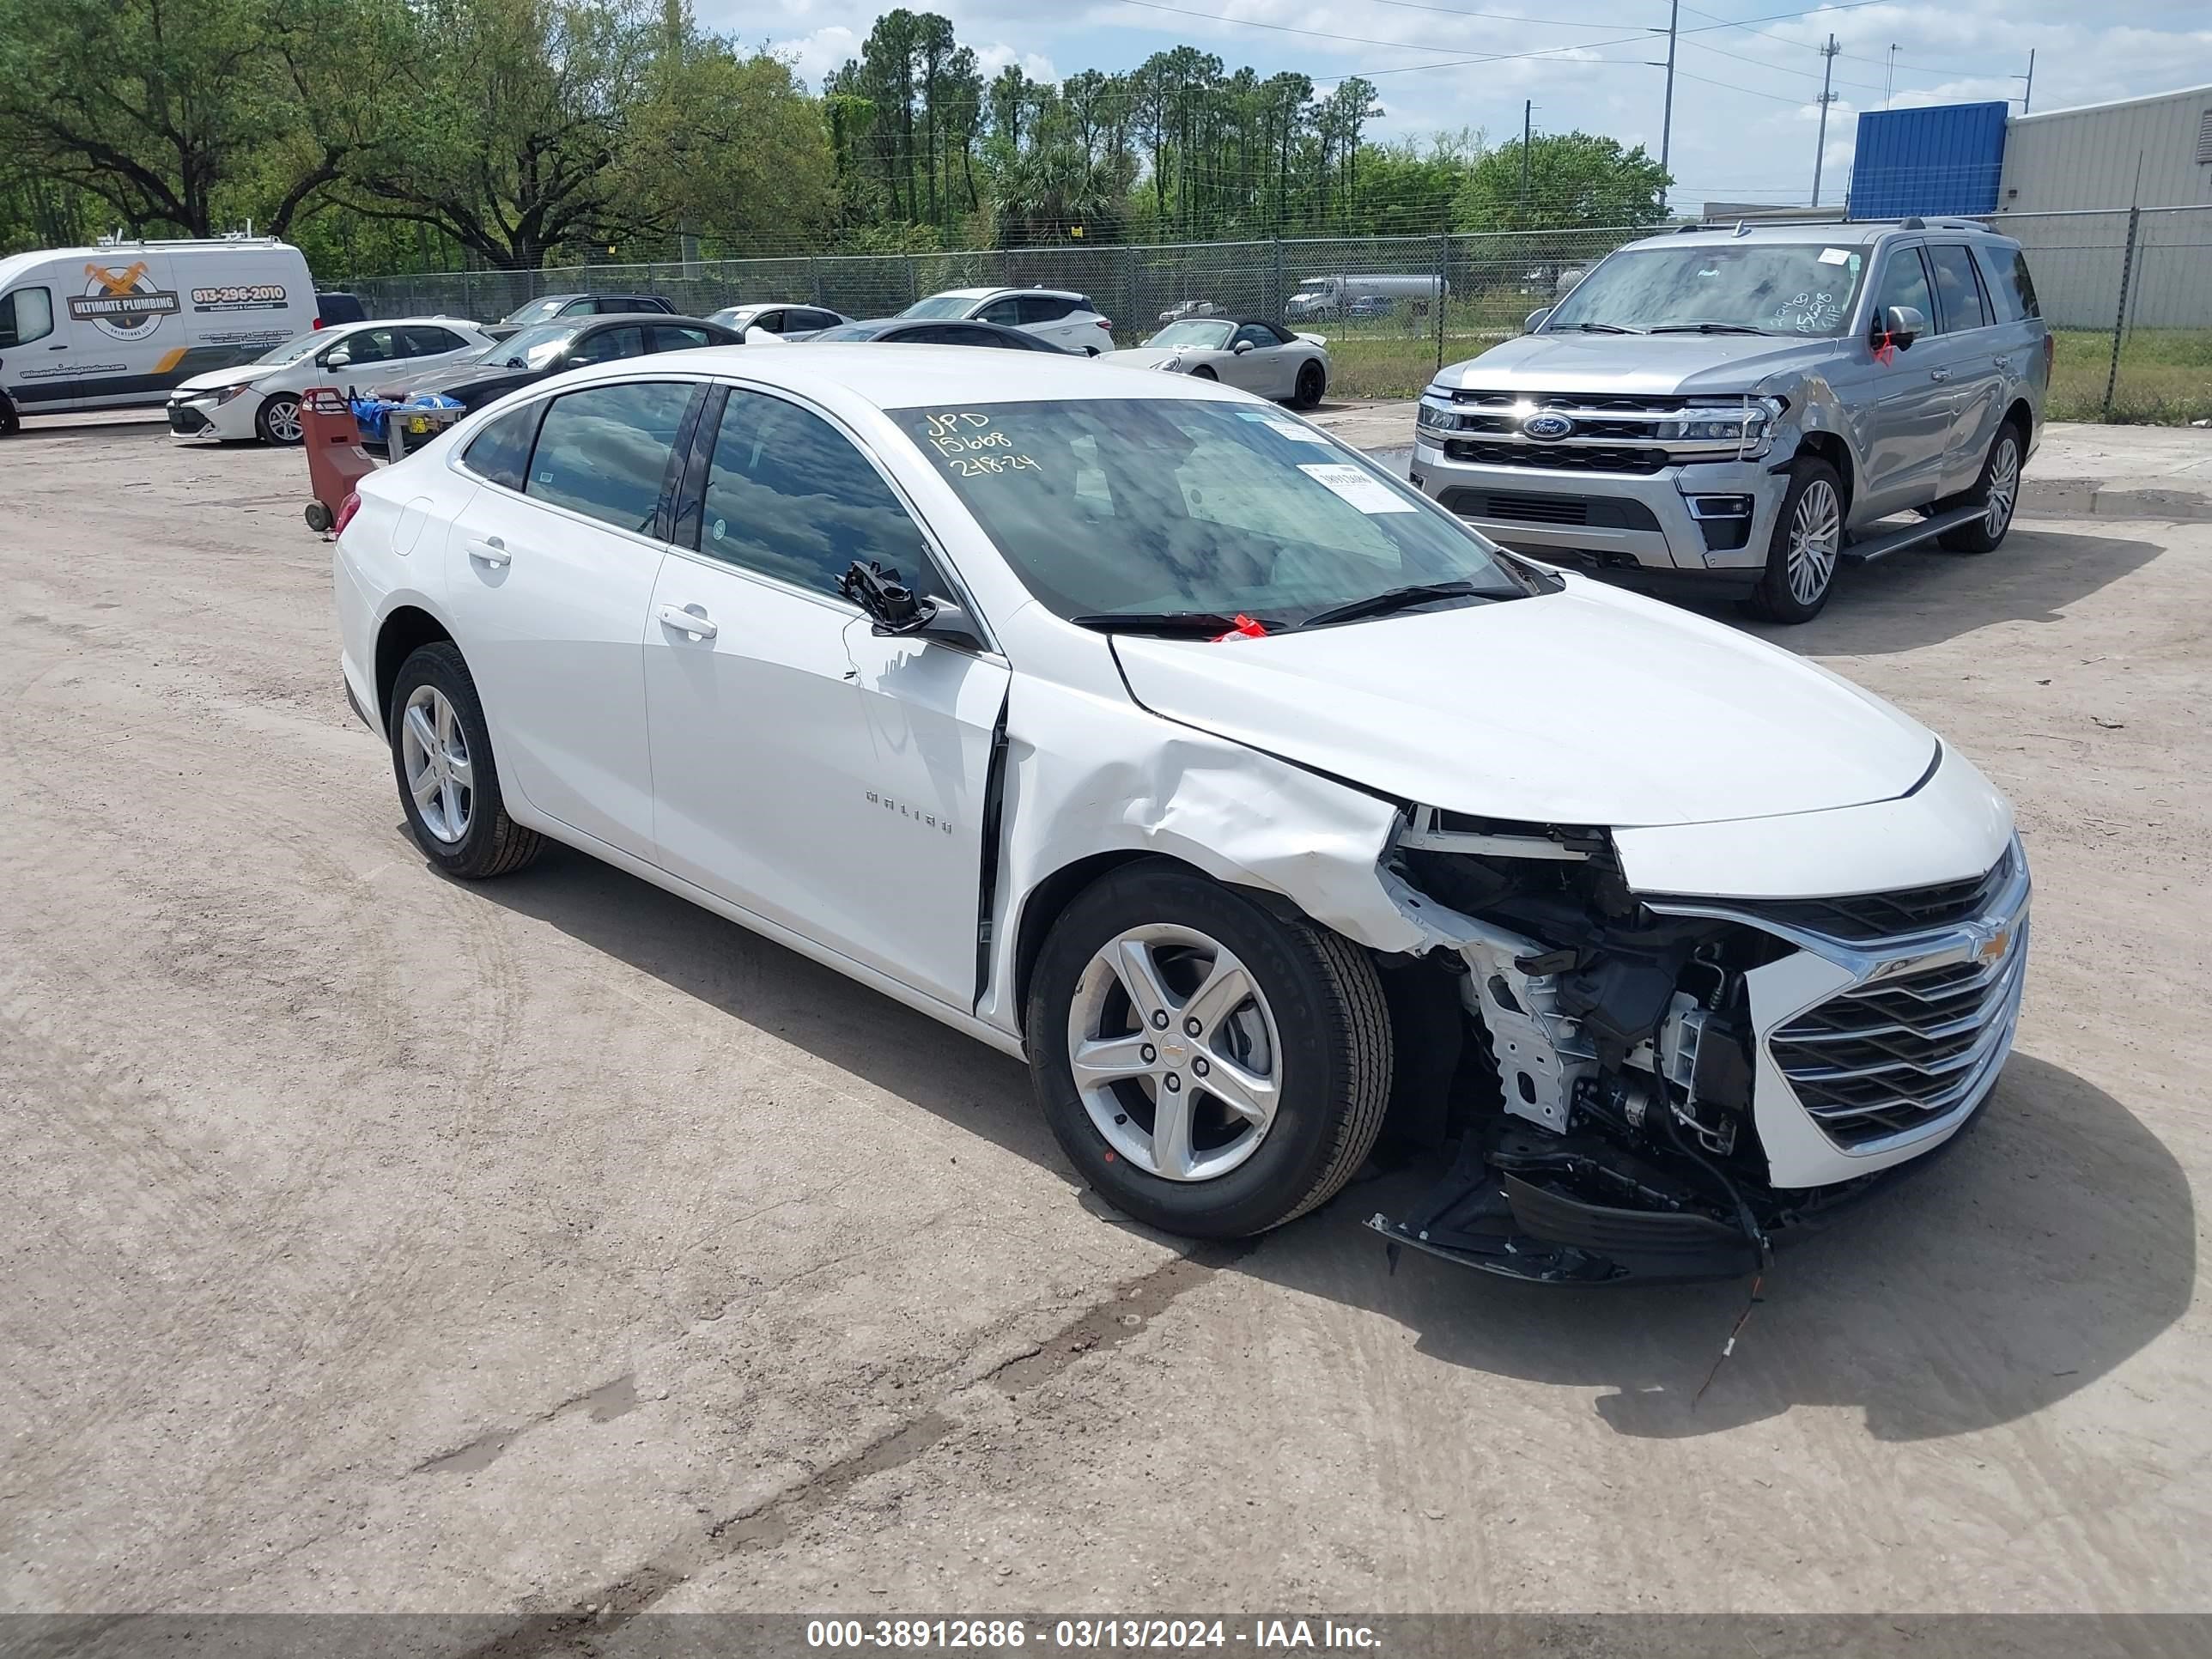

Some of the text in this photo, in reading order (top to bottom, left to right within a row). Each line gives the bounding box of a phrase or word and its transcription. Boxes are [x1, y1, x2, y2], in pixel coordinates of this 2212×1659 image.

[192, 286, 284, 302] 813-296-2010
[74, 296, 174, 313] ULTIMATE PLUMBING
[926, 413, 989, 437] JPD
[1532, 419, 1560, 433] Ford
[929, 432, 1012, 458] 15668
[866, 789, 952, 835] MALIBU
